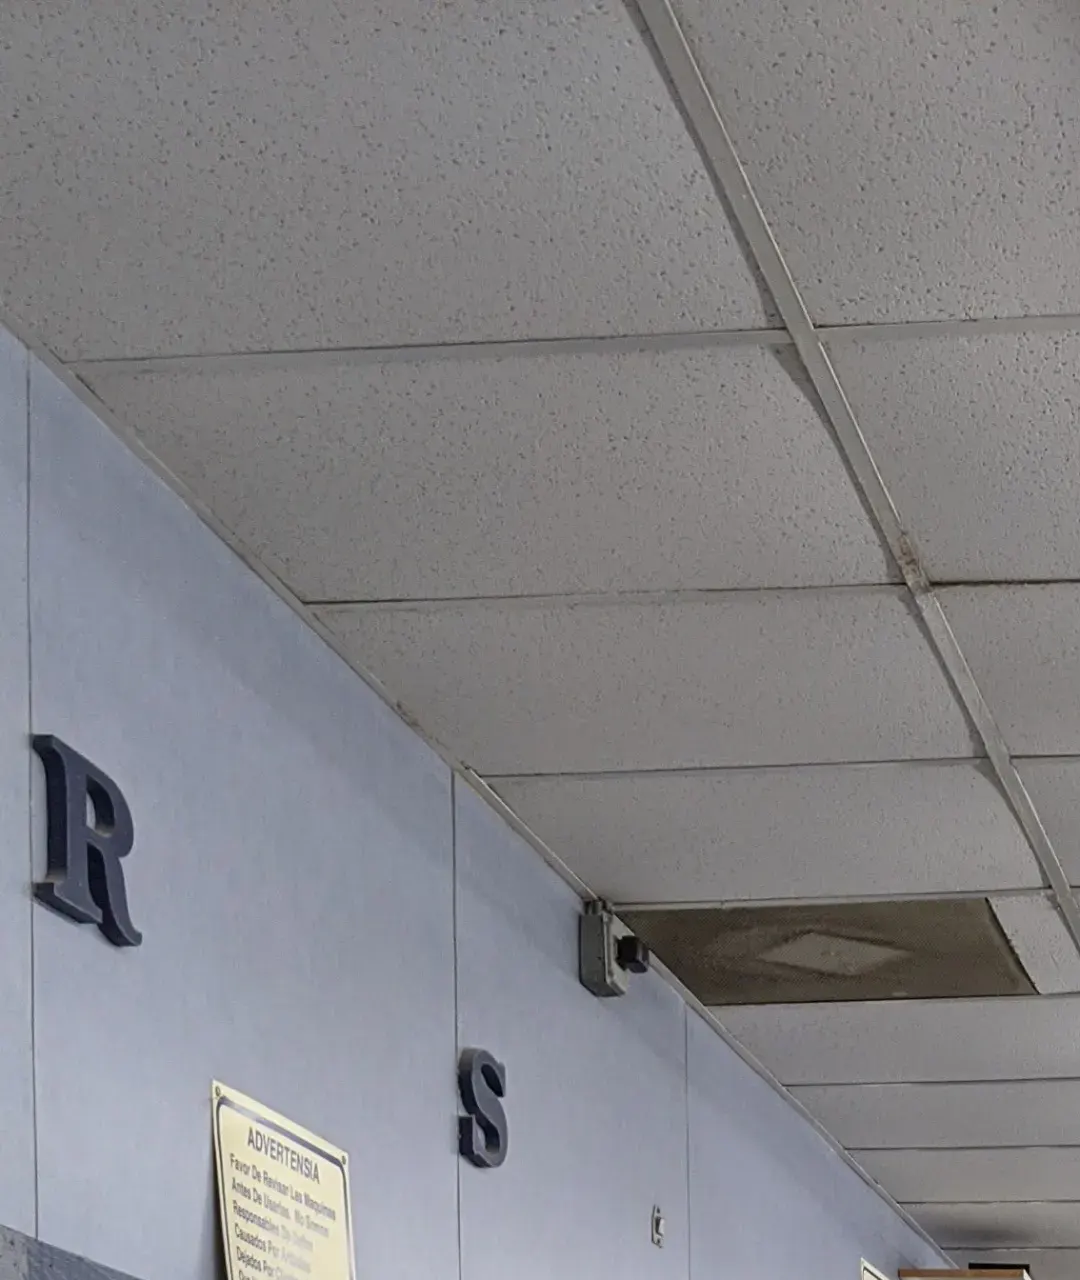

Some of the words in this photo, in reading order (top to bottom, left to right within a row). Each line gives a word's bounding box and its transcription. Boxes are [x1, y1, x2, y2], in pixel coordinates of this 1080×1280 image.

[32, 734, 142, 947] R
[457, 1047, 508, 1168] S
[230, 1153, 250, 1176] Favor
[252, 1164, 262, 1182] De
[247, 1126, 320, 1184] ADVERTENSIA
[231, 1177, 251, 1200] Antes
[235, 1222, 266, 1252] Causados
[236, 1245, 262, 1272] Dejados
